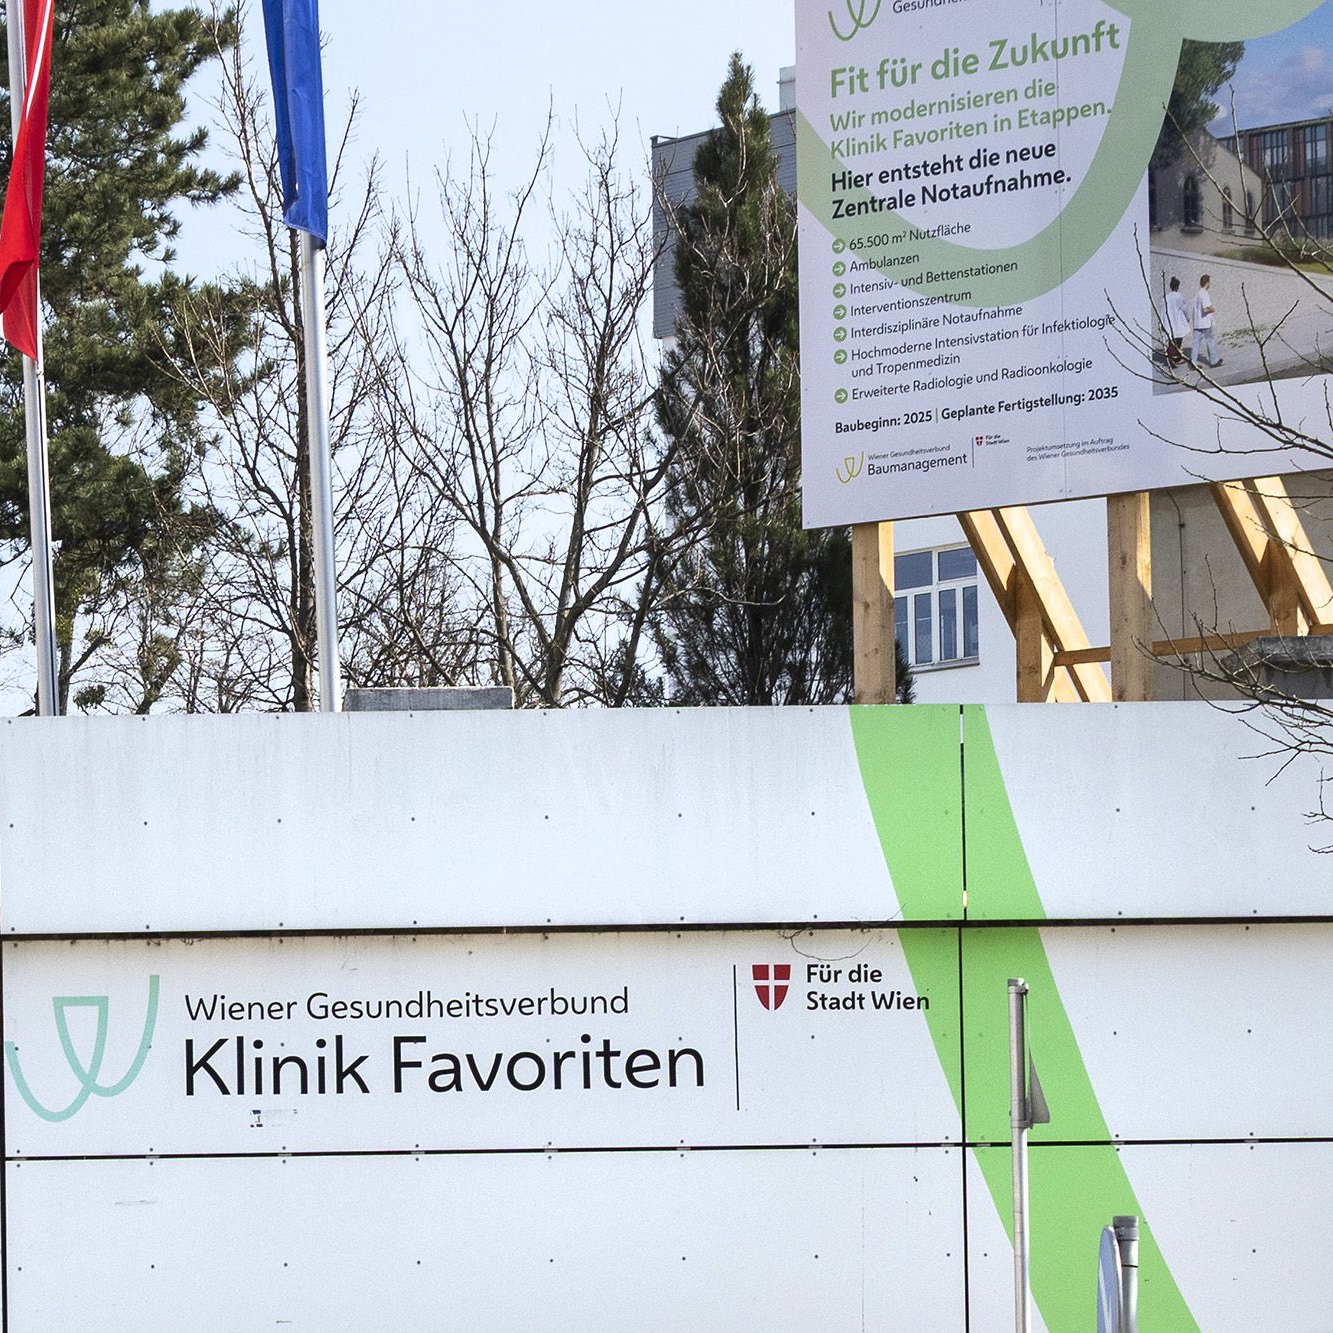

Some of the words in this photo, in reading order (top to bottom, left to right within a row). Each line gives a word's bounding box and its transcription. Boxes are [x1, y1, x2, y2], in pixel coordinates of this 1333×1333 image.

[831, 66, 869, 98] Fit
[877, 57, 923, 89] für
[930, 47, 979, 80] die
[989, 20, 1120, 71] Zukunft
[830, 112, 865, 132] Wir
[871, 88, 1018, 126] modernisieren
[1024, 79, 1056, 98] die
[830, 133, 887, 159] Klinik
[893, 117, 988, 149] Favoriten
[993, 114, 1012, 133] in
[1018, 100, 1112, 128] Etappen.
[832, 170, 873, 192] Hier
[878, 153, 963, 184] entsteht
[969, 149, 1000, 171] die
[1005, 142, 1056, 164] neue
[832, 189, 916, 219] Zentrale
[922, 169, 1071, 205] Notaufnahme.
[849, 233, 890, 251] 65.500
[909, 222, 971, 242] Nutzfläche
[849, 254, 920, 272] Ambulanzen
[850, 278, 899, 295] Intensiv-
[901, 272, 923, 287] und
[926, 261, 1018, 283] Bettenstationen
[850, 290, 972, 317] Interventionszentrum
[851, 315, 940, 339] Interdisziplinäre
[942, 305, 1023, 326] Notaufnahme
[851, 339, 932, 361] Hochmoderne
[935, 327, 1019, 350] Intensivstation
[1022, 323, 1039, 338] für
[1041, 314, 1115, 336] Infektiologie
[851, 363, 874, 378] und
[876, 353, 960, 377] Tropenmedizin
[852, 382, 910, 401] Erweiterte
[913, 373, 974, 393] Radiologie
[976, 368, 998, 383] und
[1001, 357, 1093, 380] Radioonkologie
[835, 413, 901, 434] Baubeginn:
[903, 409, 932, 425] 2025
[941, 403, 996, 425] Geplante
[998, 391, 1085, 413] Fertigstellung:
[1087, 386, 1118, 402] 2035
[868, 453, 968, 475] Baumanagement
[806, 964, 843, 983] Für
[848, 963, 883, 983] die
[185, 993, 298, 1021] Wiener
[306, 986, 630, 1020] Gesundheitsverbund
[806, 990, 865, 1011] Stadt
[871, 990, 930, 1010] Wien
[185, 1034, 371, 1097] Klinik
[393, 1033, 704, 1094] Favoriten
